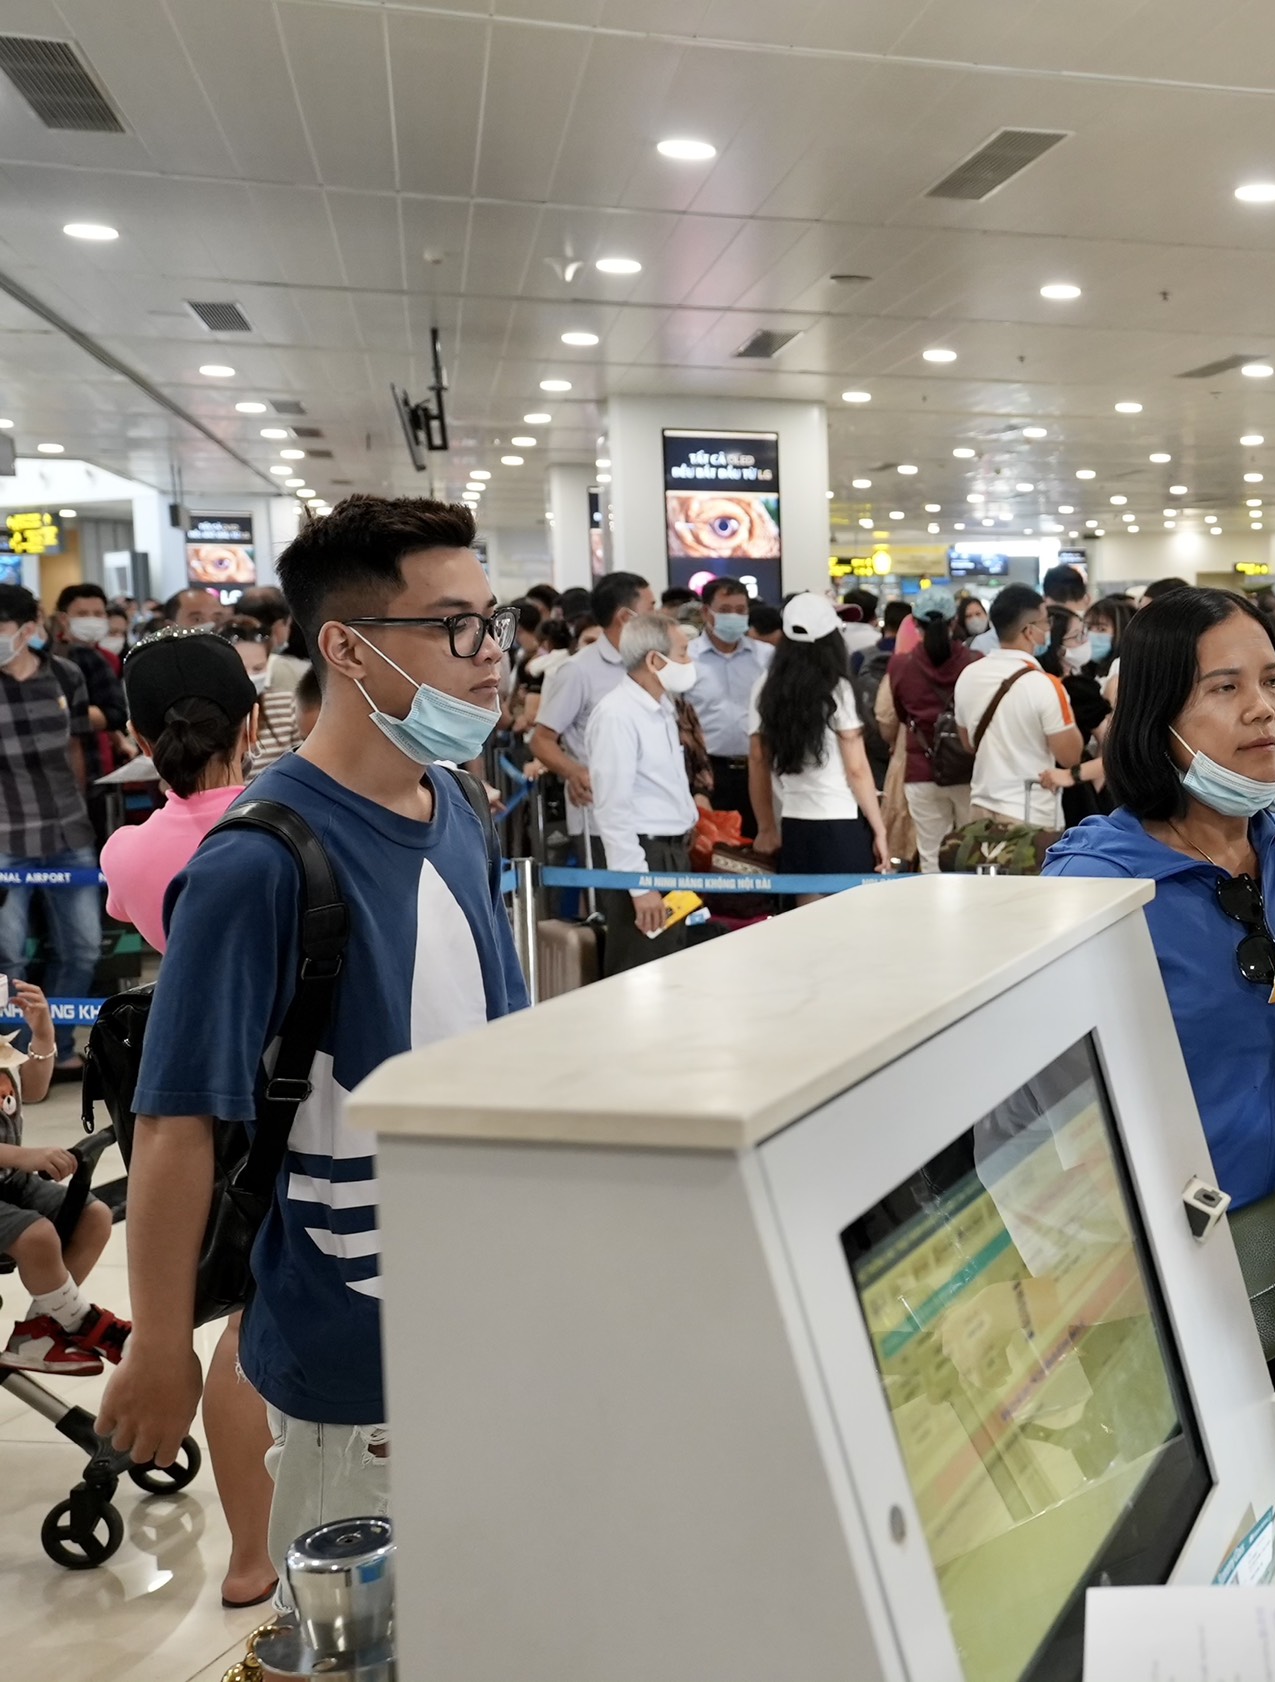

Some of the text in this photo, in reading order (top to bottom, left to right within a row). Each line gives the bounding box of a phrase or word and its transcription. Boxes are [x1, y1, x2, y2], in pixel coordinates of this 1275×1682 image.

[0, 872, 72, 883] NAL AIRPORT
[50, 1004, 75, 1019] NG
